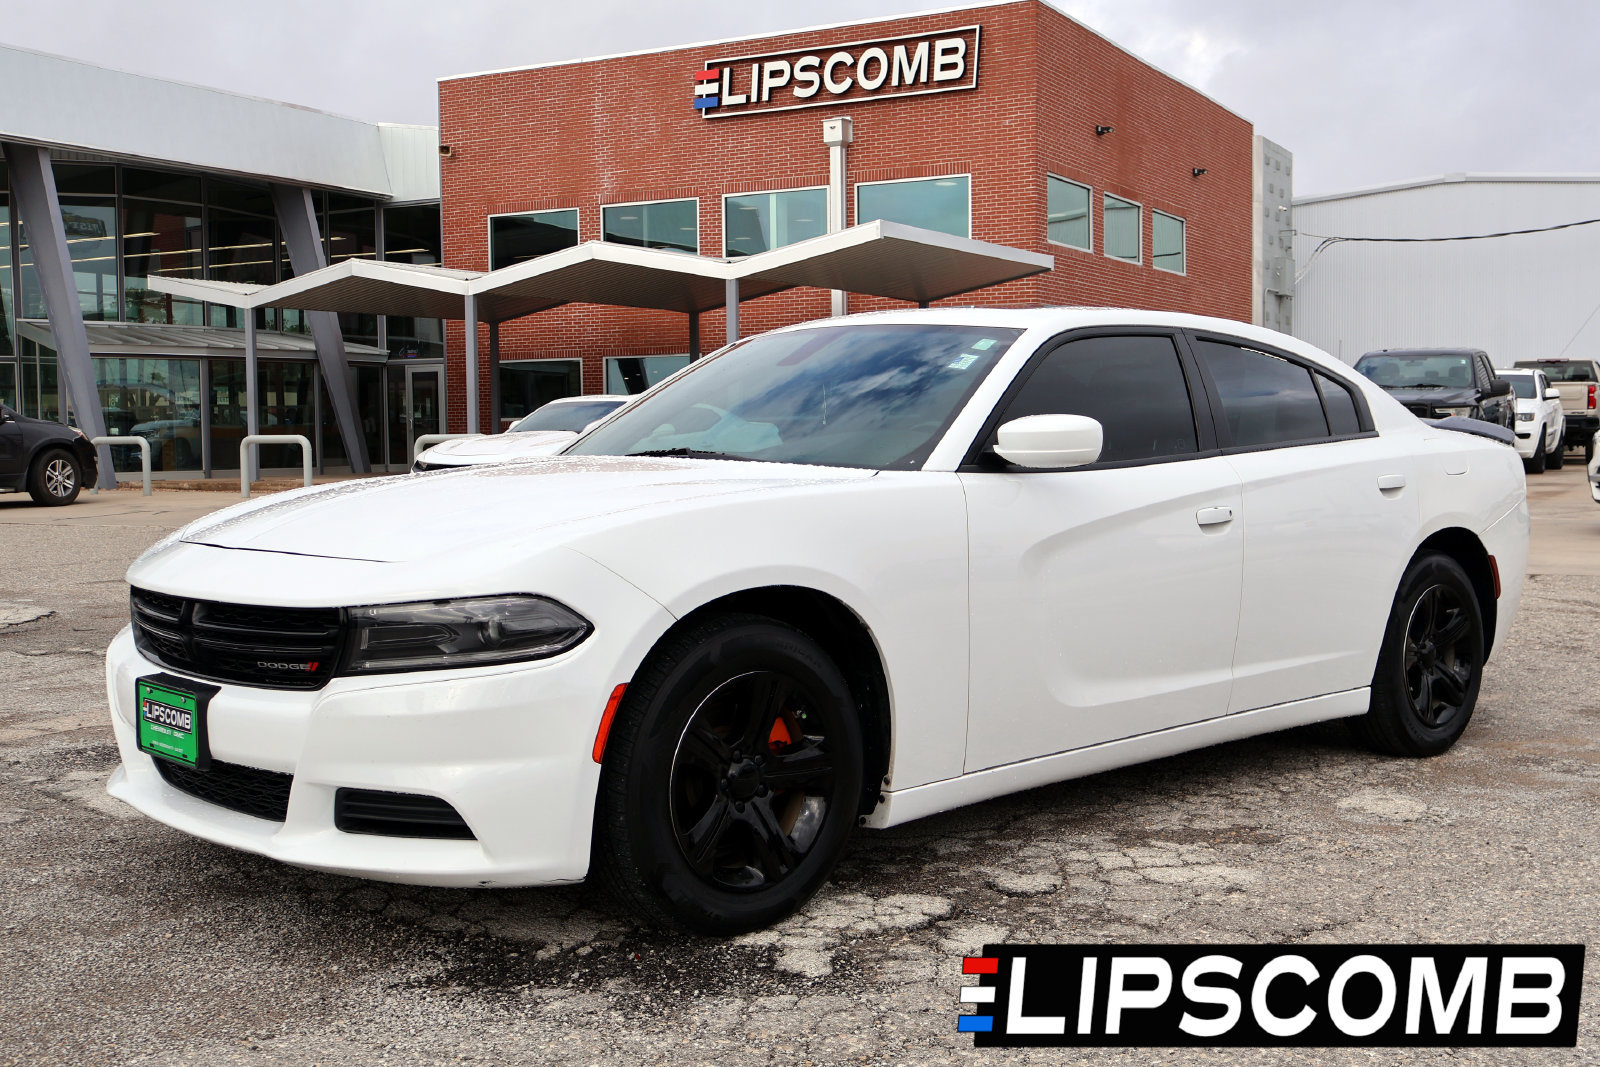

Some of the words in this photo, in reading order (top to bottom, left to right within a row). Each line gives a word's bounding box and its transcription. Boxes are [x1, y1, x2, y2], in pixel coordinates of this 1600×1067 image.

[721, 37, 967, 106] LIPSCOMB
[257, 661, 312, 670] DODGE
[146, 702, 191, 730] LIPSCOMB
